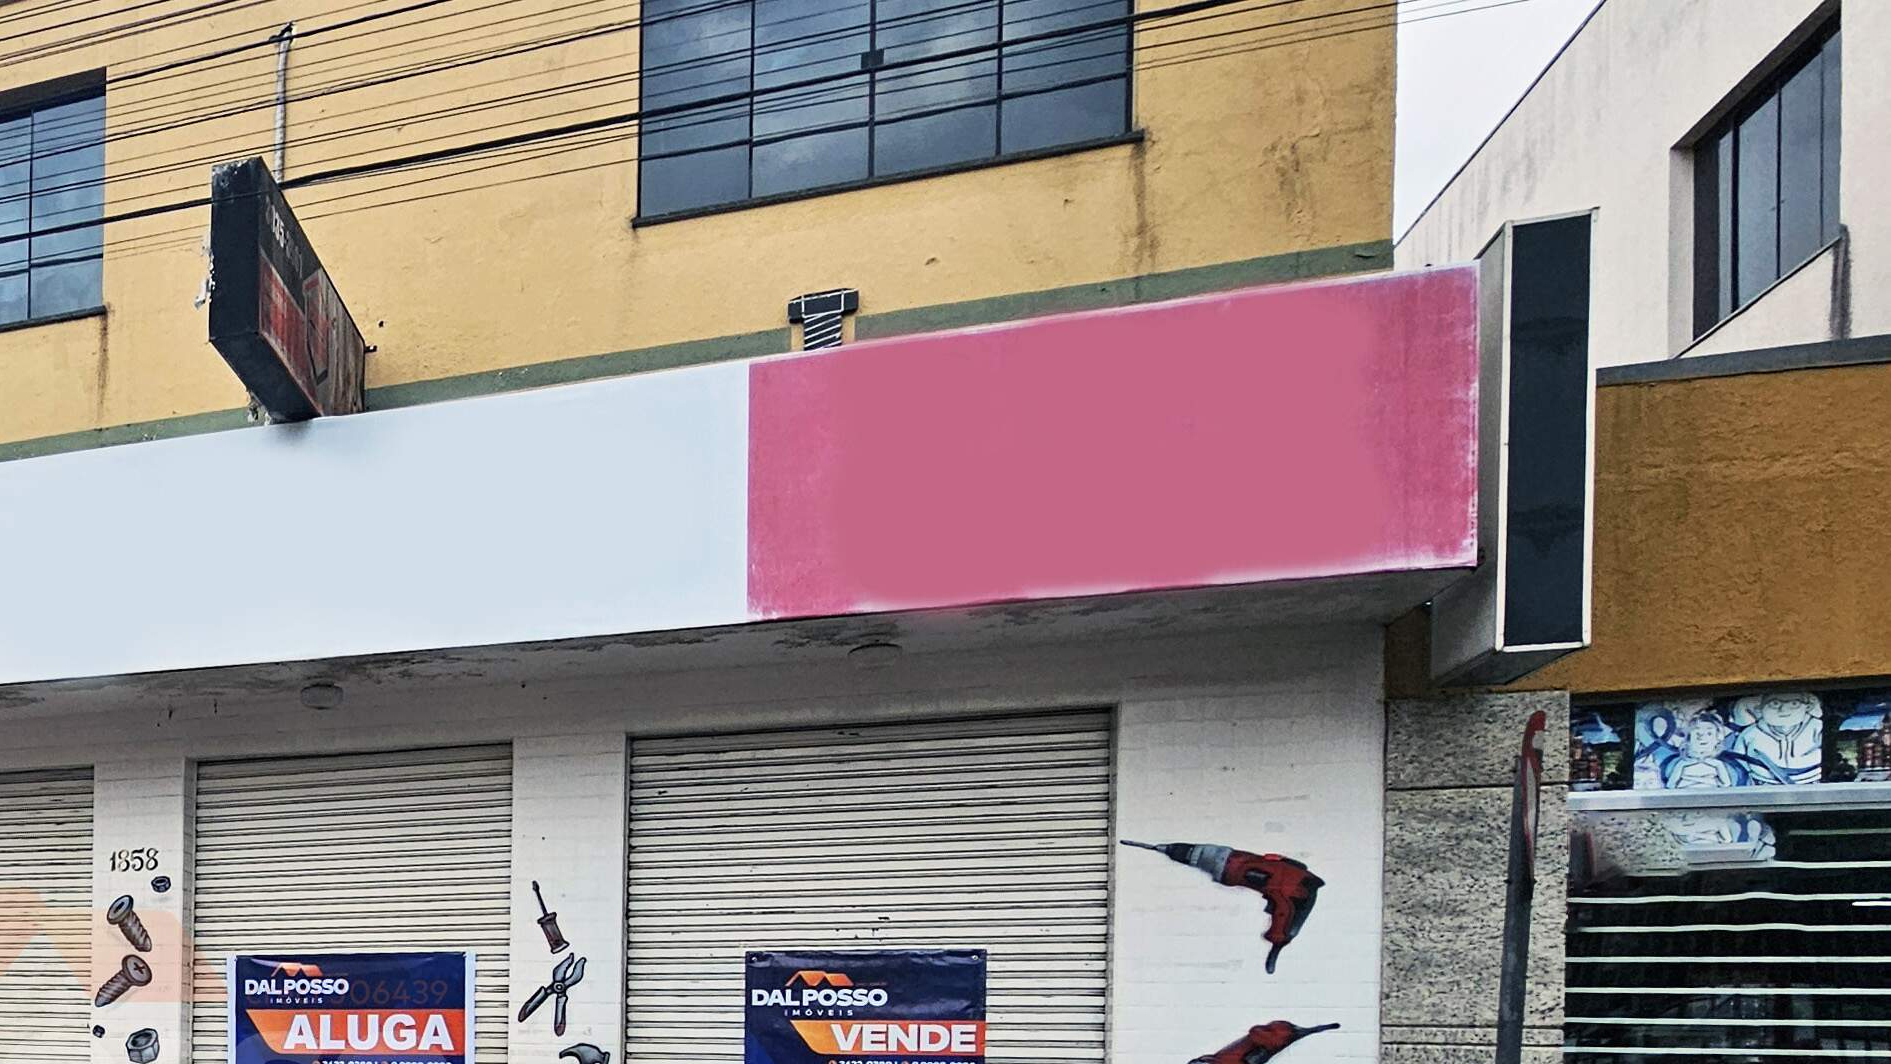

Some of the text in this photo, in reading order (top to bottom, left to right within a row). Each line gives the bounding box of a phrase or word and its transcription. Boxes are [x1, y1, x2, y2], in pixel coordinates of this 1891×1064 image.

[110, 847, 159, 872] 1858
[269, 996, 324, 1004] IMÓVEIS
[801, 988, 889, 1006] POSSO
[784, 1008, 853, 1017] IMÓVEIS
[283, 1013, 455, 1051] ALUGA
[830, 1023, 977, 1053] VENDE
